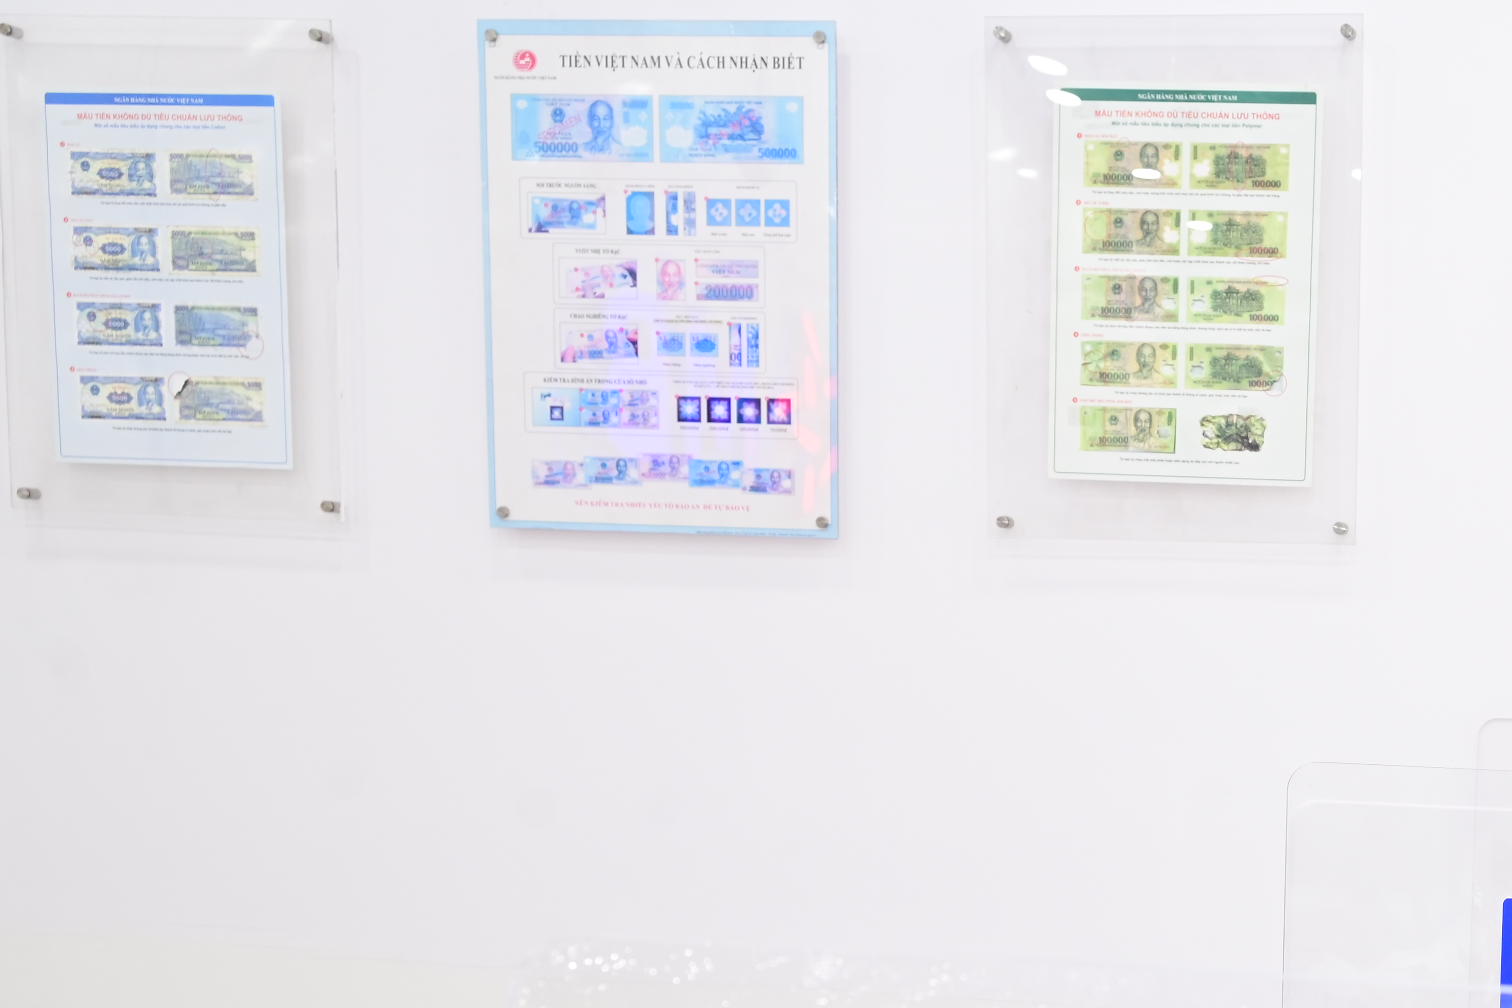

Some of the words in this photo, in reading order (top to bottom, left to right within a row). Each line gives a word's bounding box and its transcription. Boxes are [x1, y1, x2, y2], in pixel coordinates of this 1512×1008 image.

[595, 54, 628, 72] VIỆT
[630, 55, 661, 69] NAM
[664, 51, 684, 69] VÀ
[686, 51, 725, 69] CÁCH
